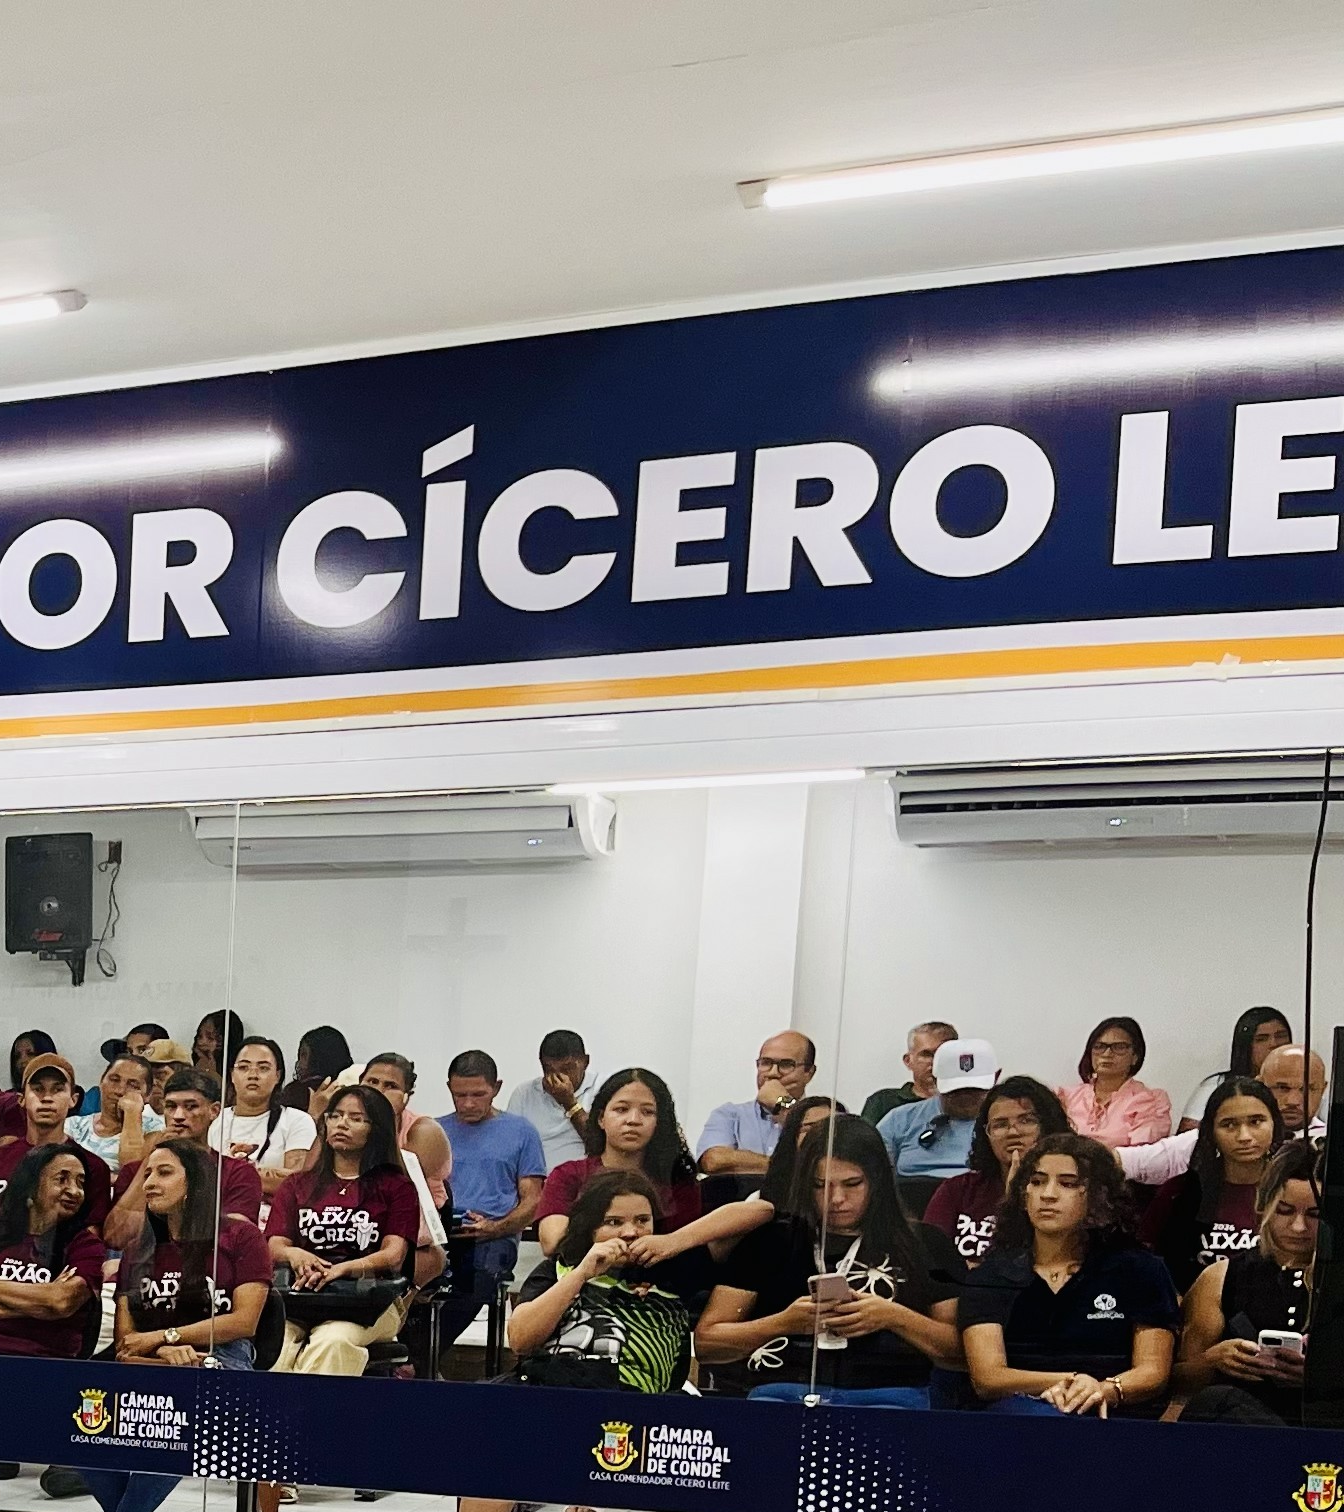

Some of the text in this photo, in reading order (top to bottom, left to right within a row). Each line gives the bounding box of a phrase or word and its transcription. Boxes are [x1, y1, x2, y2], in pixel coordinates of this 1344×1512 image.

[276, 424, 1055, 632] CÍCERO
[1112, 396, 1344, 565] LE
[120, 1391, 174, 1410] CÂMARA
[120, 1408, 189, 1426] MUNICIPAL
[119, 1422, 181, 1440] DE CONDE
[649, 1425, 713, 1445] CÂMARA
[70, 1434, 89, 1443] CASA
[91, 1436, 140, 1447] COMENDADOR
[169, 1442, 188, 1451] LEITE
[648, 1443, 731, 1463] MUNICIPAL
[647, 1458, 721, 1478] DE CONDE
[589, 1471, 611, 1481] CASA
[613, 1473, 673, 1486] COMENDADOR
[707, 1480, 730, 1490] LEITE
